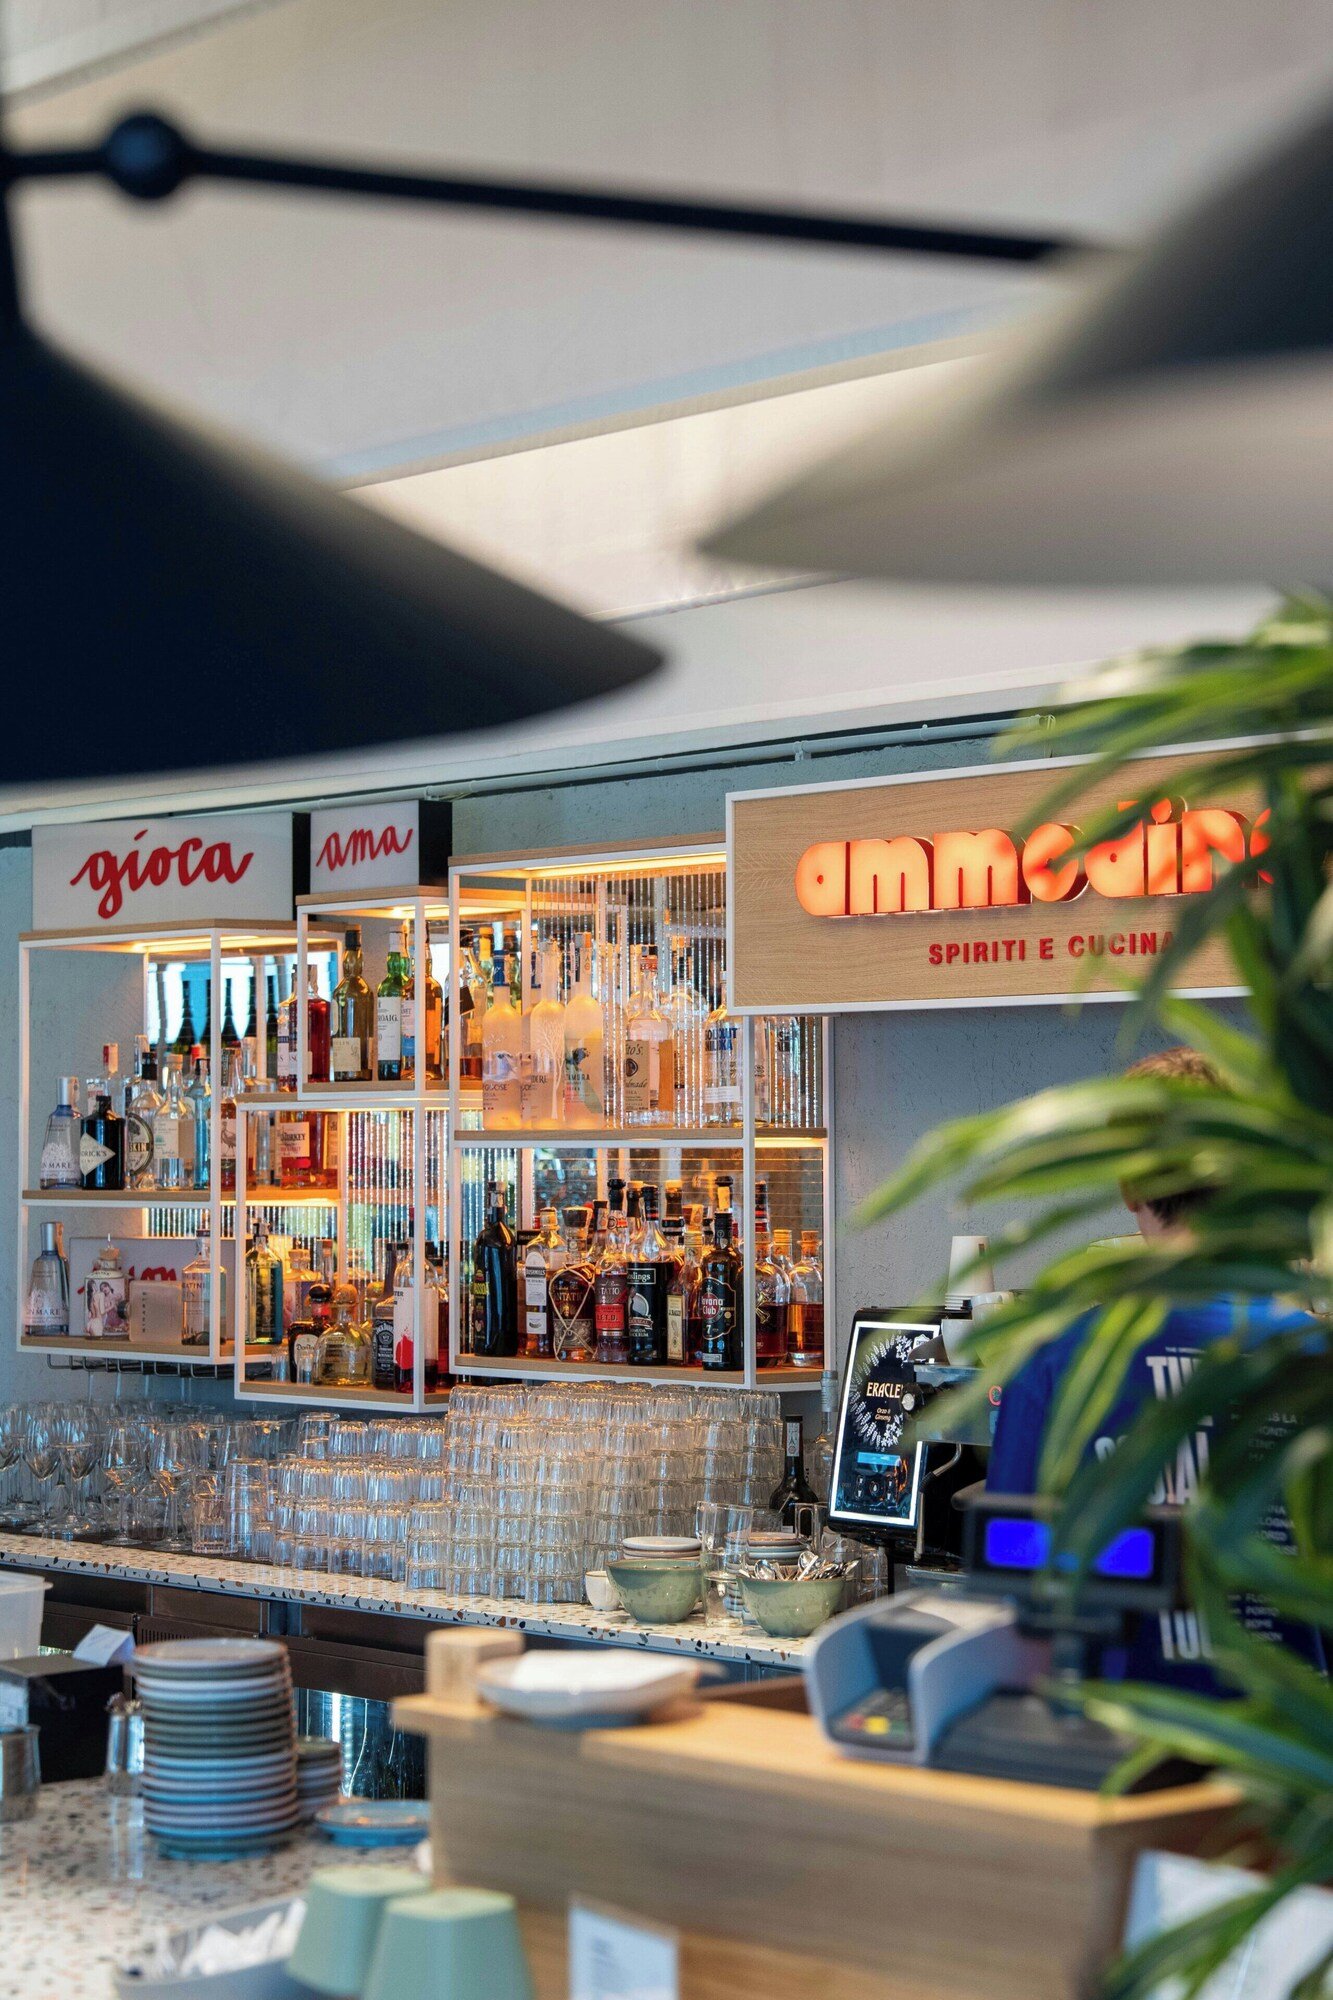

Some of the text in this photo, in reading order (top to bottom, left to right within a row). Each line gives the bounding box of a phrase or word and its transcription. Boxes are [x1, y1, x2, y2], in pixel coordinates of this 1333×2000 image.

[315, 825, 413, 872] ama
[795, 796, 1274, 917] ammodin
[70, 829, 254, 919] gioca
[928, 939, 1026, 965] SPIRITI
[1039, 937, 1054, 960] E
[49, 1161, 72, 1169] MARE
[35, 1308, 61, 1316] MARE
[702, 1306, 717, 1315] Club
